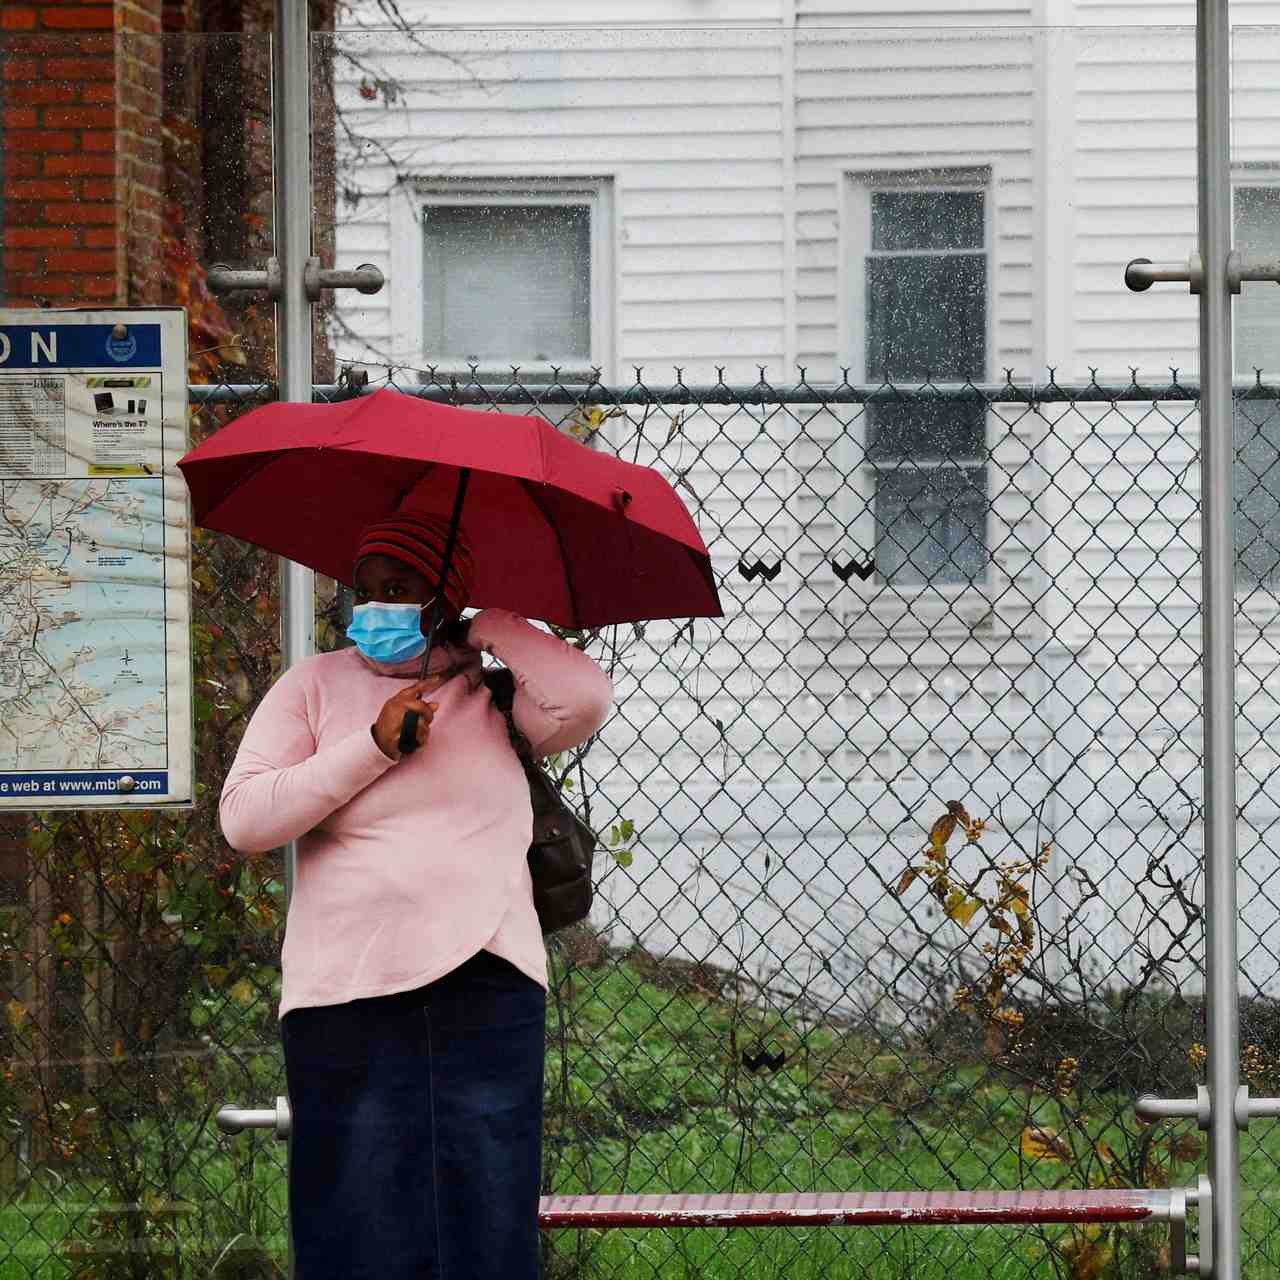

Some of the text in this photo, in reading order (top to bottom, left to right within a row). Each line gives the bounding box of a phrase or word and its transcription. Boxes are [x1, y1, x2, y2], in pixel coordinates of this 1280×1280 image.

[12, 780, 40, 792] web
[43, 780, 56, 792] at
[59, 778, 161, 792] www.mbtcom
